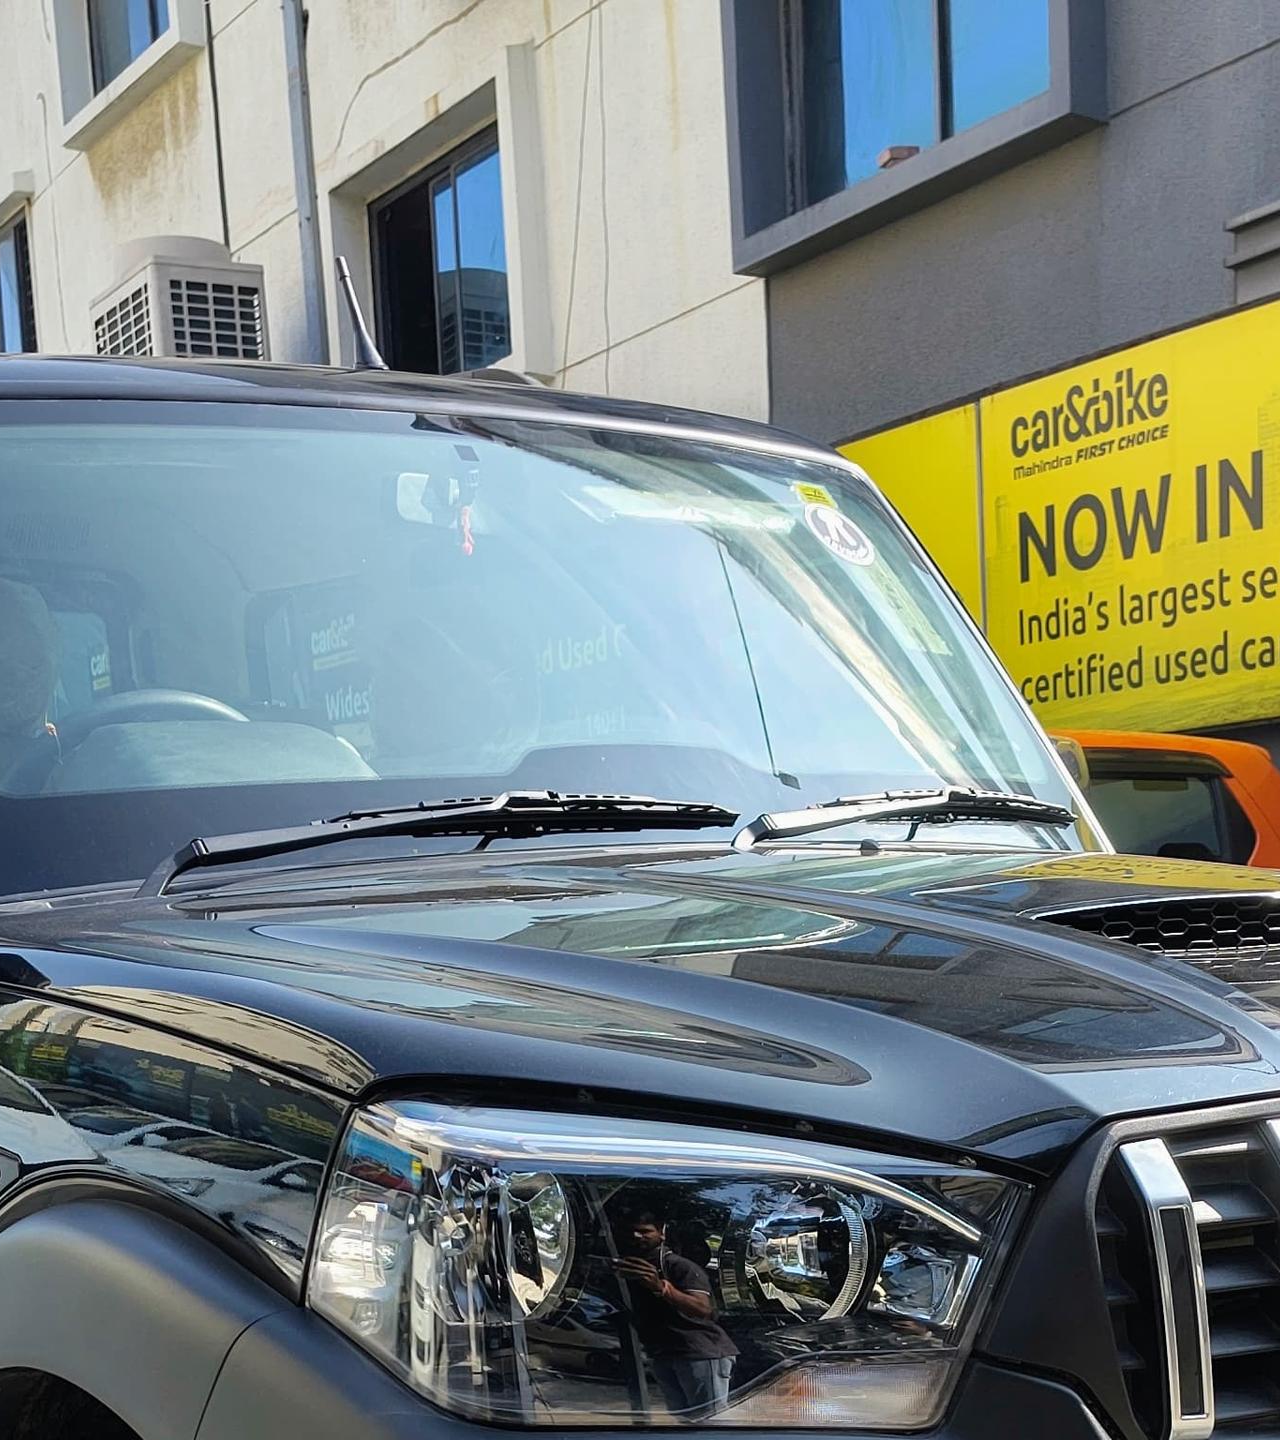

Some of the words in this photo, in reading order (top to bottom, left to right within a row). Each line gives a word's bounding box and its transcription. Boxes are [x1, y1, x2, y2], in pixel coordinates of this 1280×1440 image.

[1011, 367, 1168, 458] car&bike
[1013, 454, 1073, 480] Mahindra
[1075, 439, 1115, 463] FIRST
[1117, 424, 1169, 451] CHOICE
[1019, 473, 1172, 583] NOW
[1196, 450, 1264, 544] IN
[1018, 591, 1109, 646] India's
[1119, 568, 1231, 628] largest
[1021, 646, 1143, 705] certified
[1155, 630, 1229, 683] used
